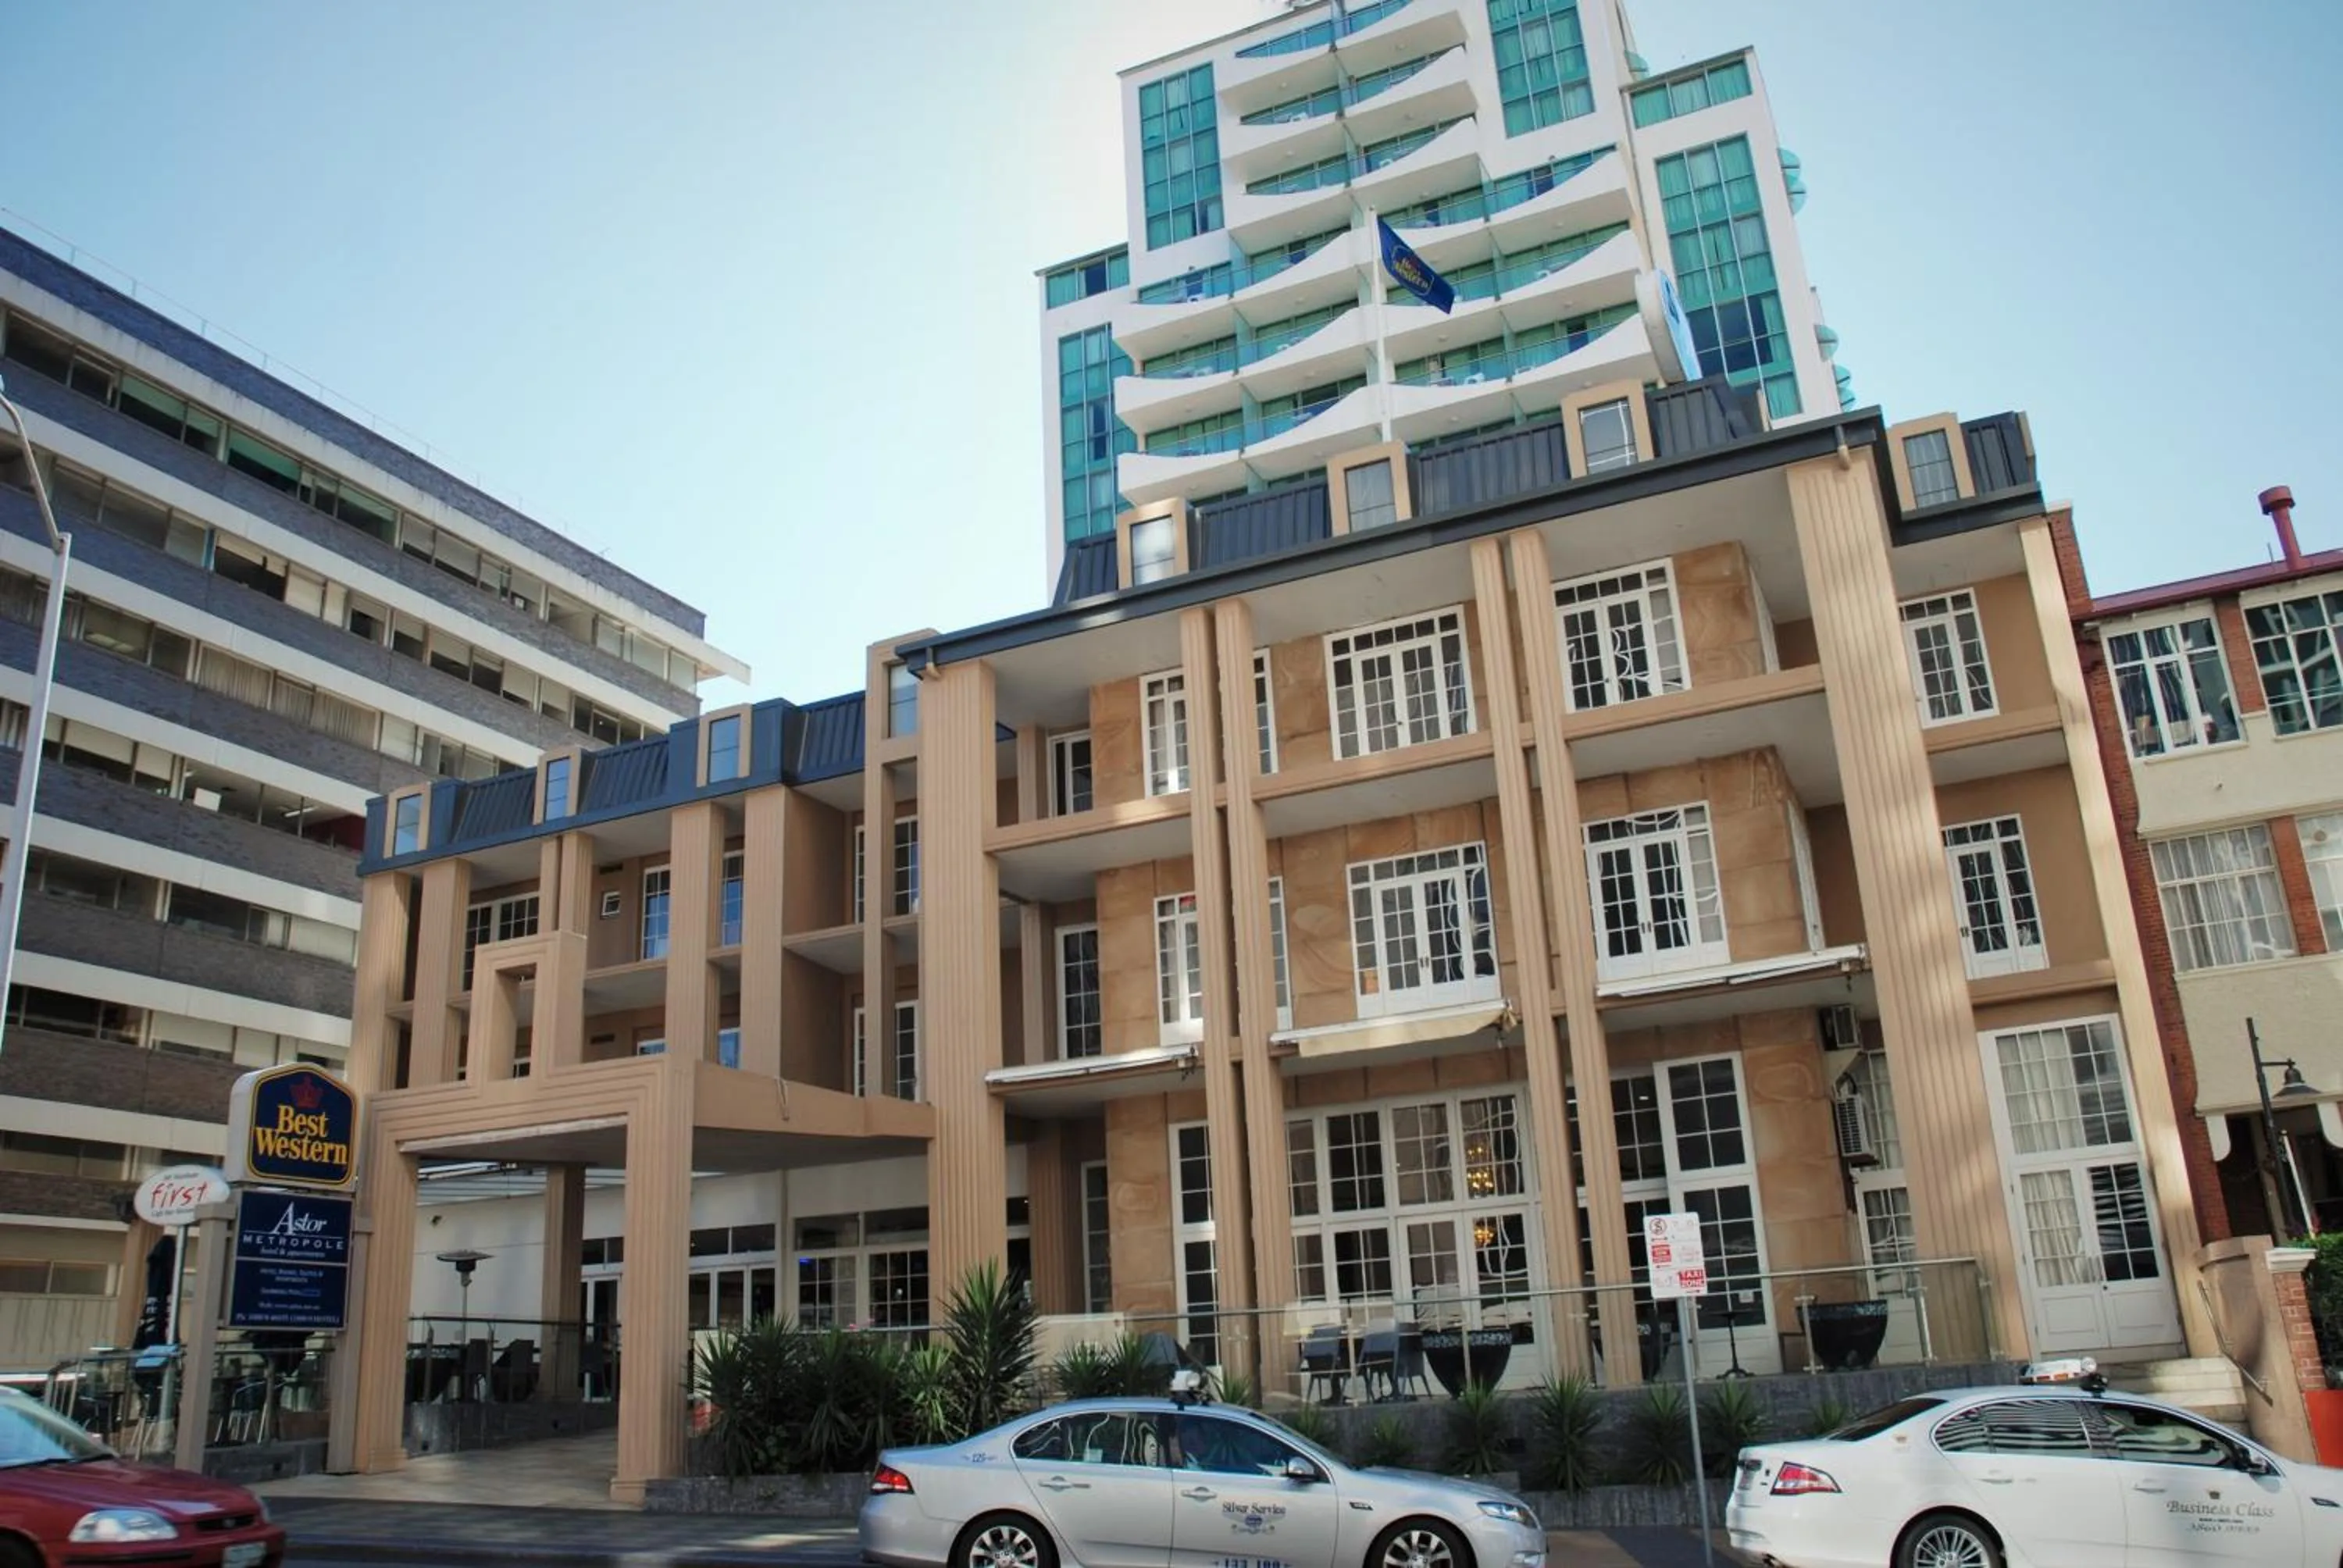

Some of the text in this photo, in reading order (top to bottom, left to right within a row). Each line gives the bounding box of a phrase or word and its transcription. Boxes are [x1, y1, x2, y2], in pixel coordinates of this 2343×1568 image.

[277, 1105, 330, 1137] Best
[253, 1127, 347, 1164] Western
[151, 1181, 207, 1208] first
[269, 1201, 328, 1235] Astor
[243, 1235, 344, 1249] METROPOLE
[1222, 1502, 1287, 1514] Silver Service
[2166, 1501, 2275, 1516] Business Class
